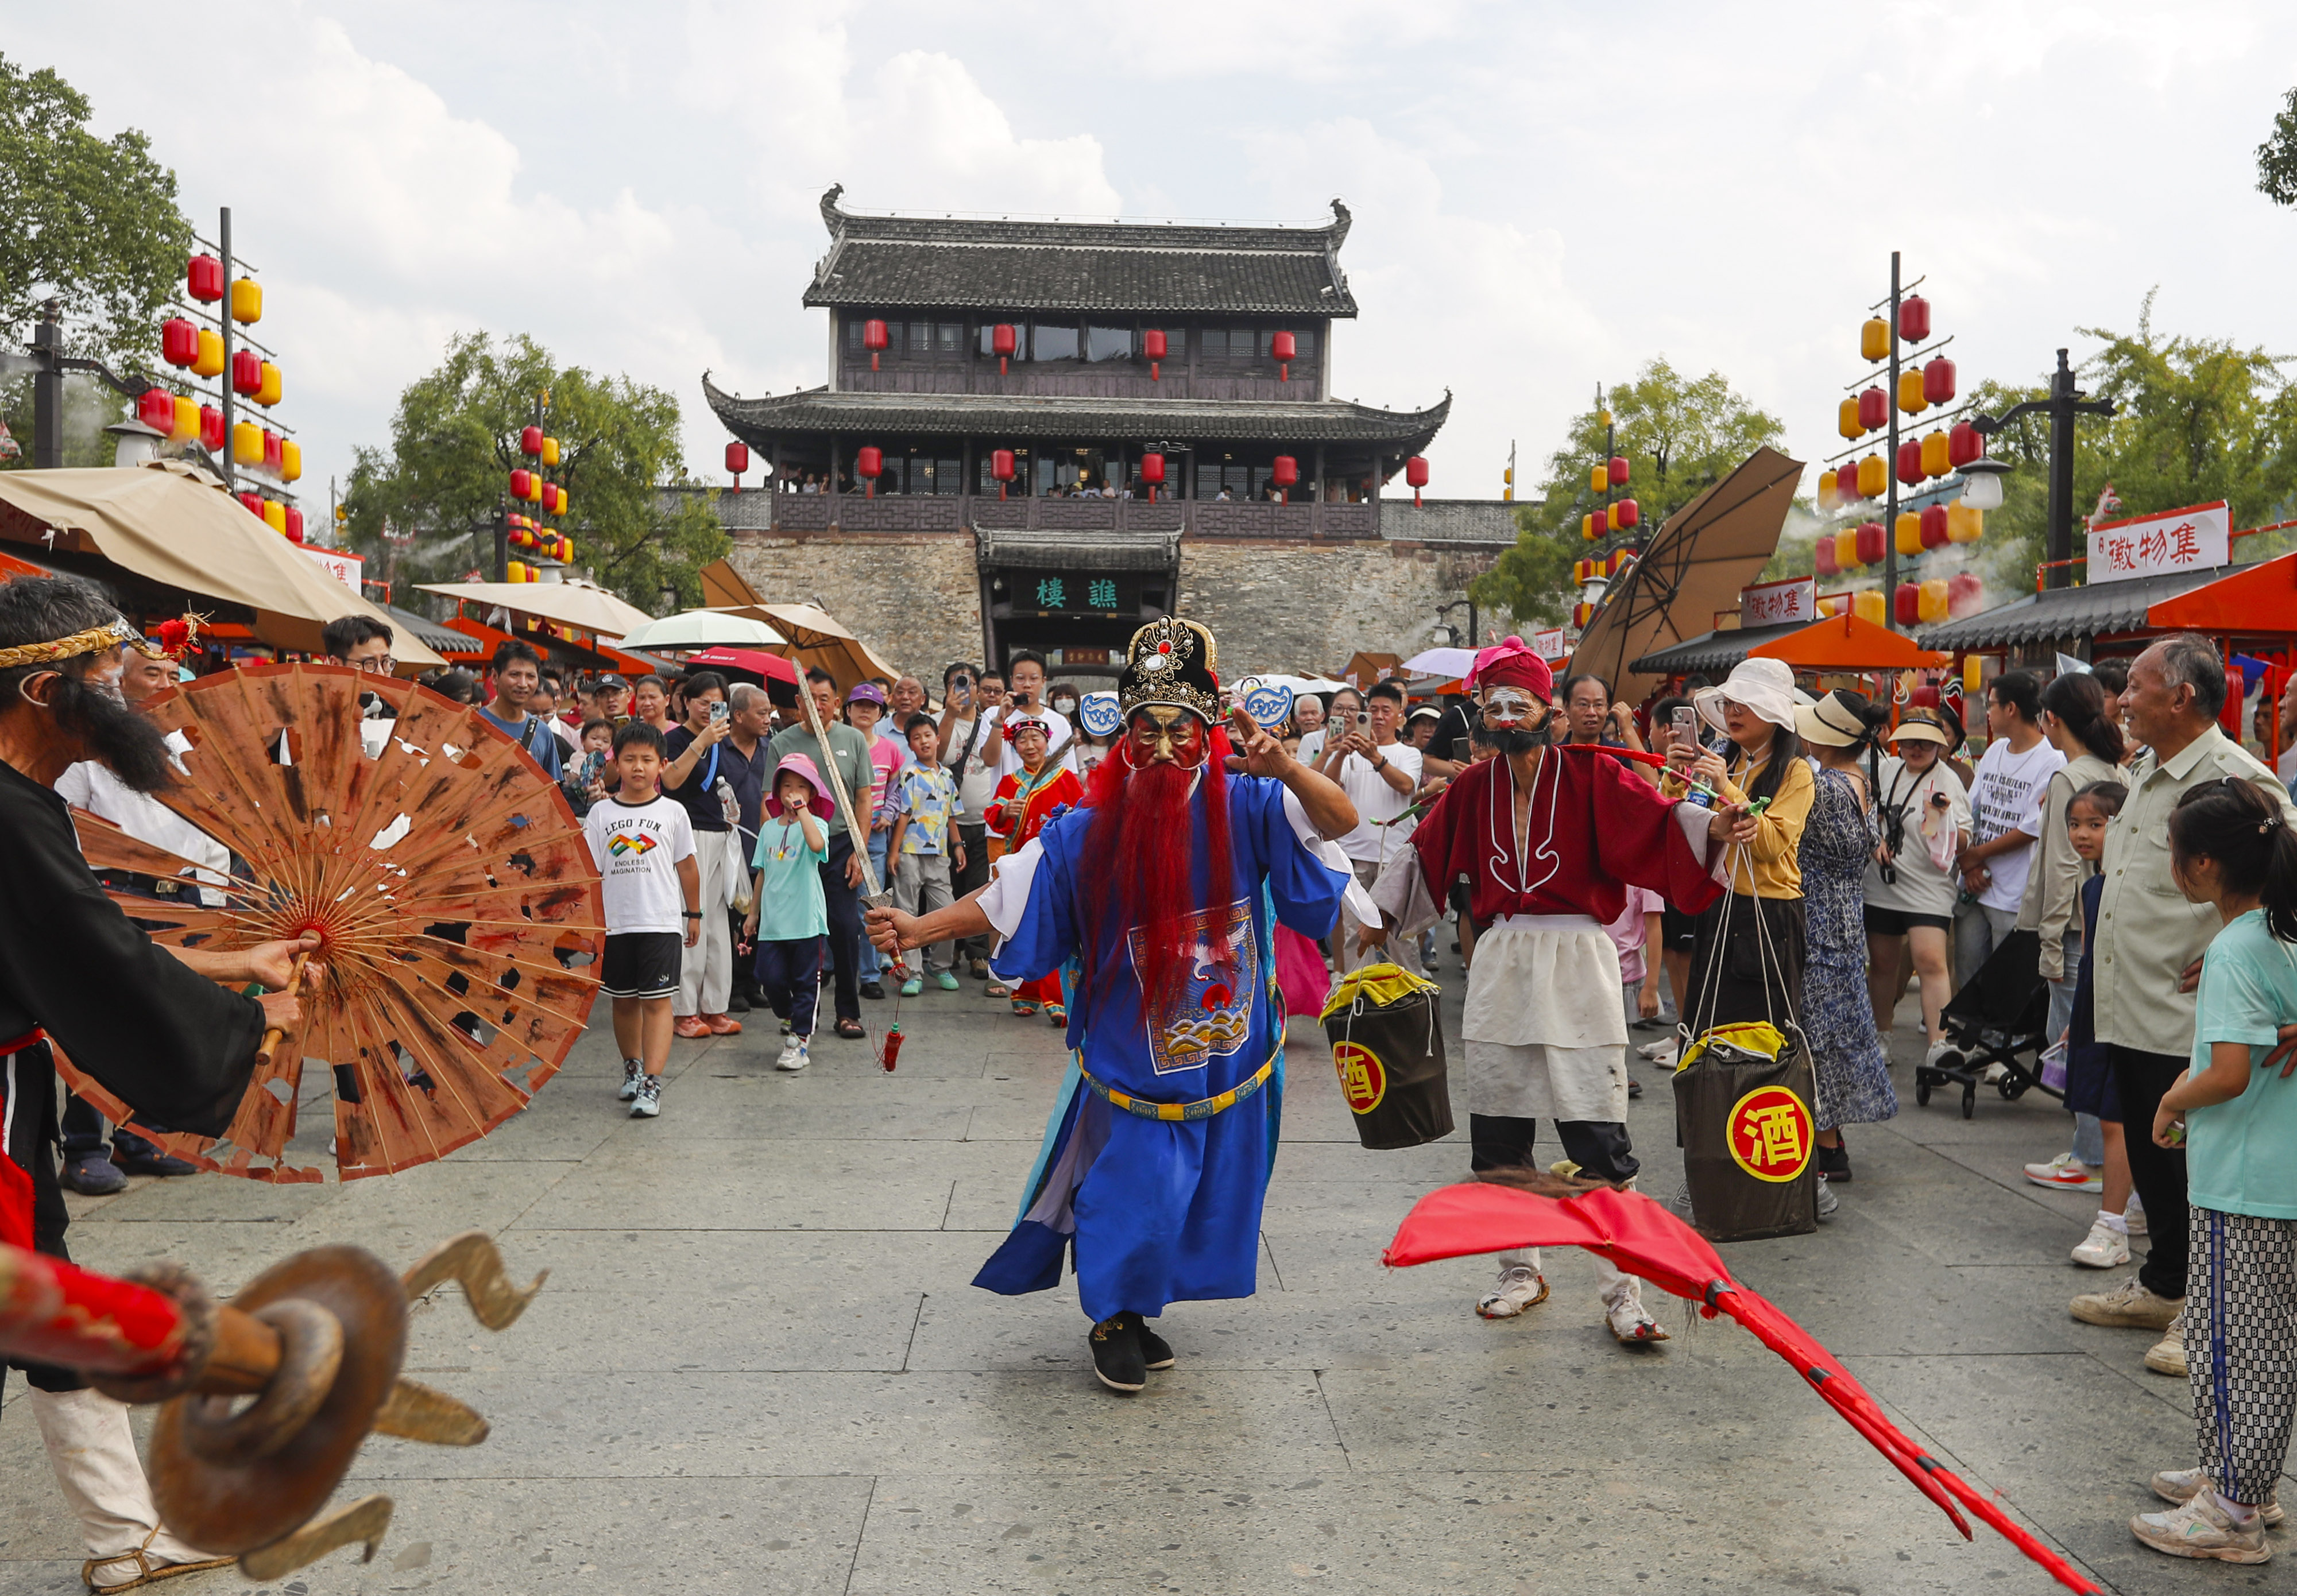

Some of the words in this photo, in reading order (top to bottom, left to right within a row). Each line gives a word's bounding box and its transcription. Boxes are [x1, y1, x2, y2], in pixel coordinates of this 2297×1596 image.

[2109, 522, 2201, 573] 徽物集
[1752, 588, 1800, 619] 徽物集
[605, 819, 634, 836] LEGO
[639, 819, 662, 832] FUN
[615, 859, 645, 867] ENDLESS
[1337, 1054, 1375, 1101] 酒
[1742, 1103, 1802, 1166] 酒
